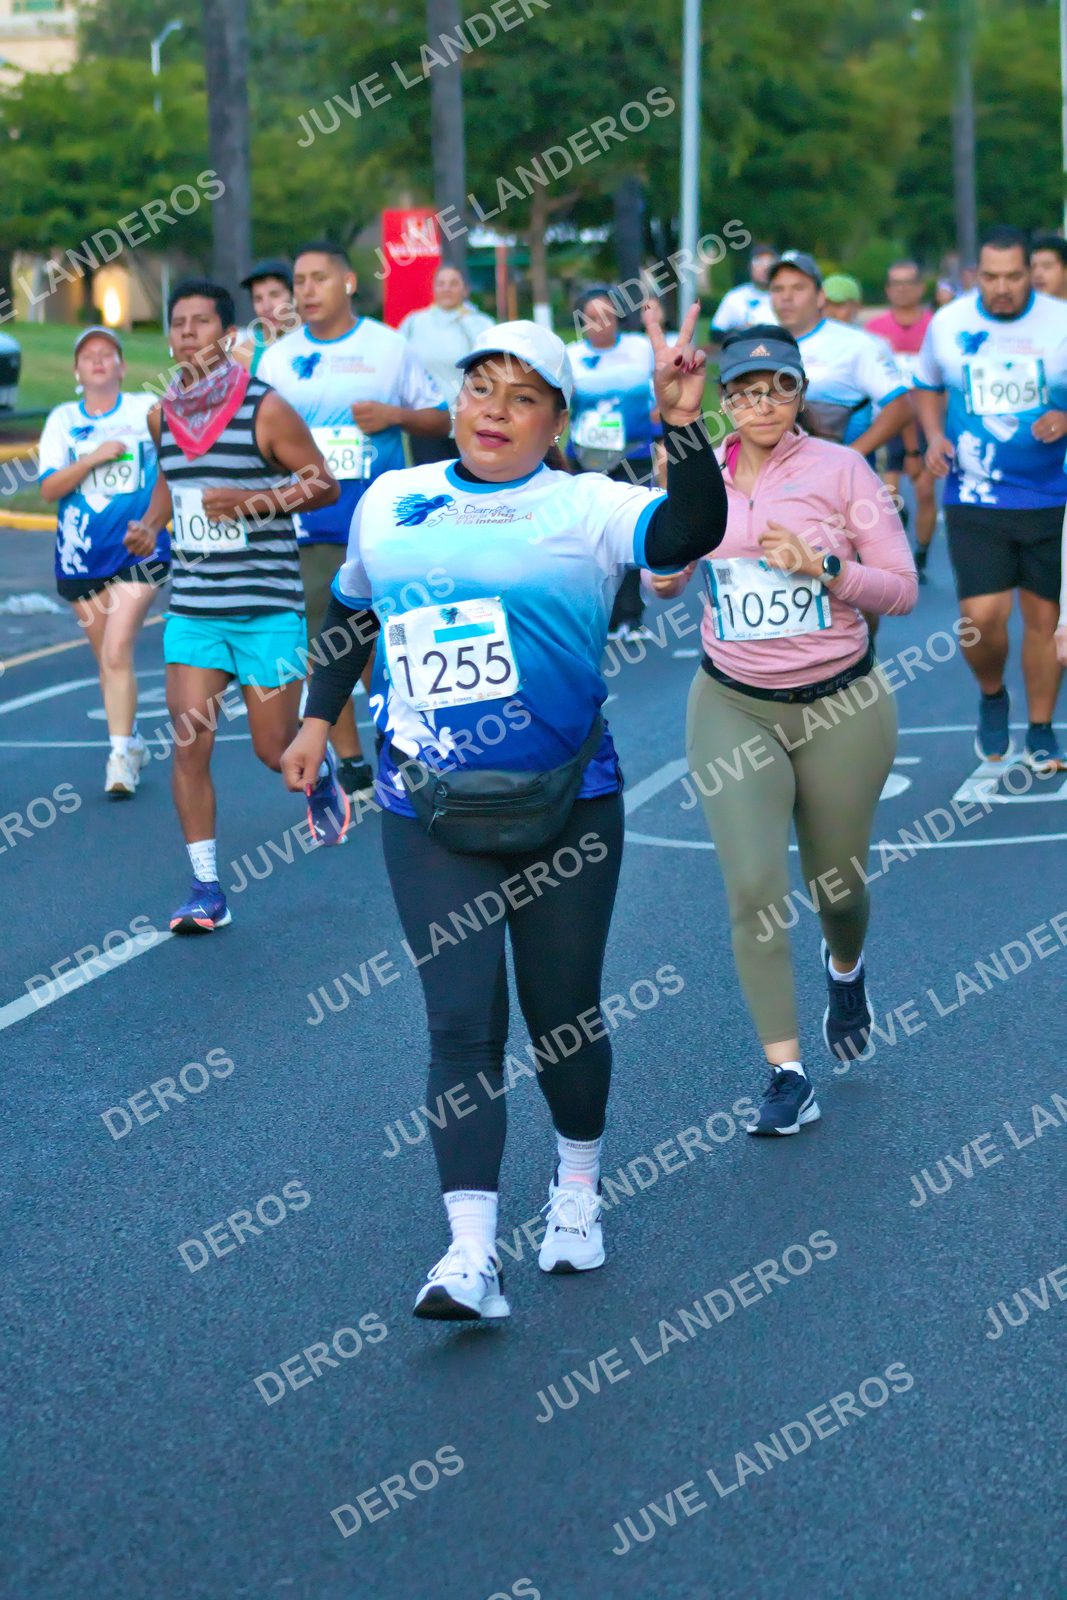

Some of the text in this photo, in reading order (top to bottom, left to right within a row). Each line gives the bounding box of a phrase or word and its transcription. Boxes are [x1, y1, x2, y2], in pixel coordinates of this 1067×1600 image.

[976, 382, 1036, 406] 1905
[327, 450, 355, 473] 68
[723, 587, 812, 628] 1059
[397, 640, 511, 698] 1255
